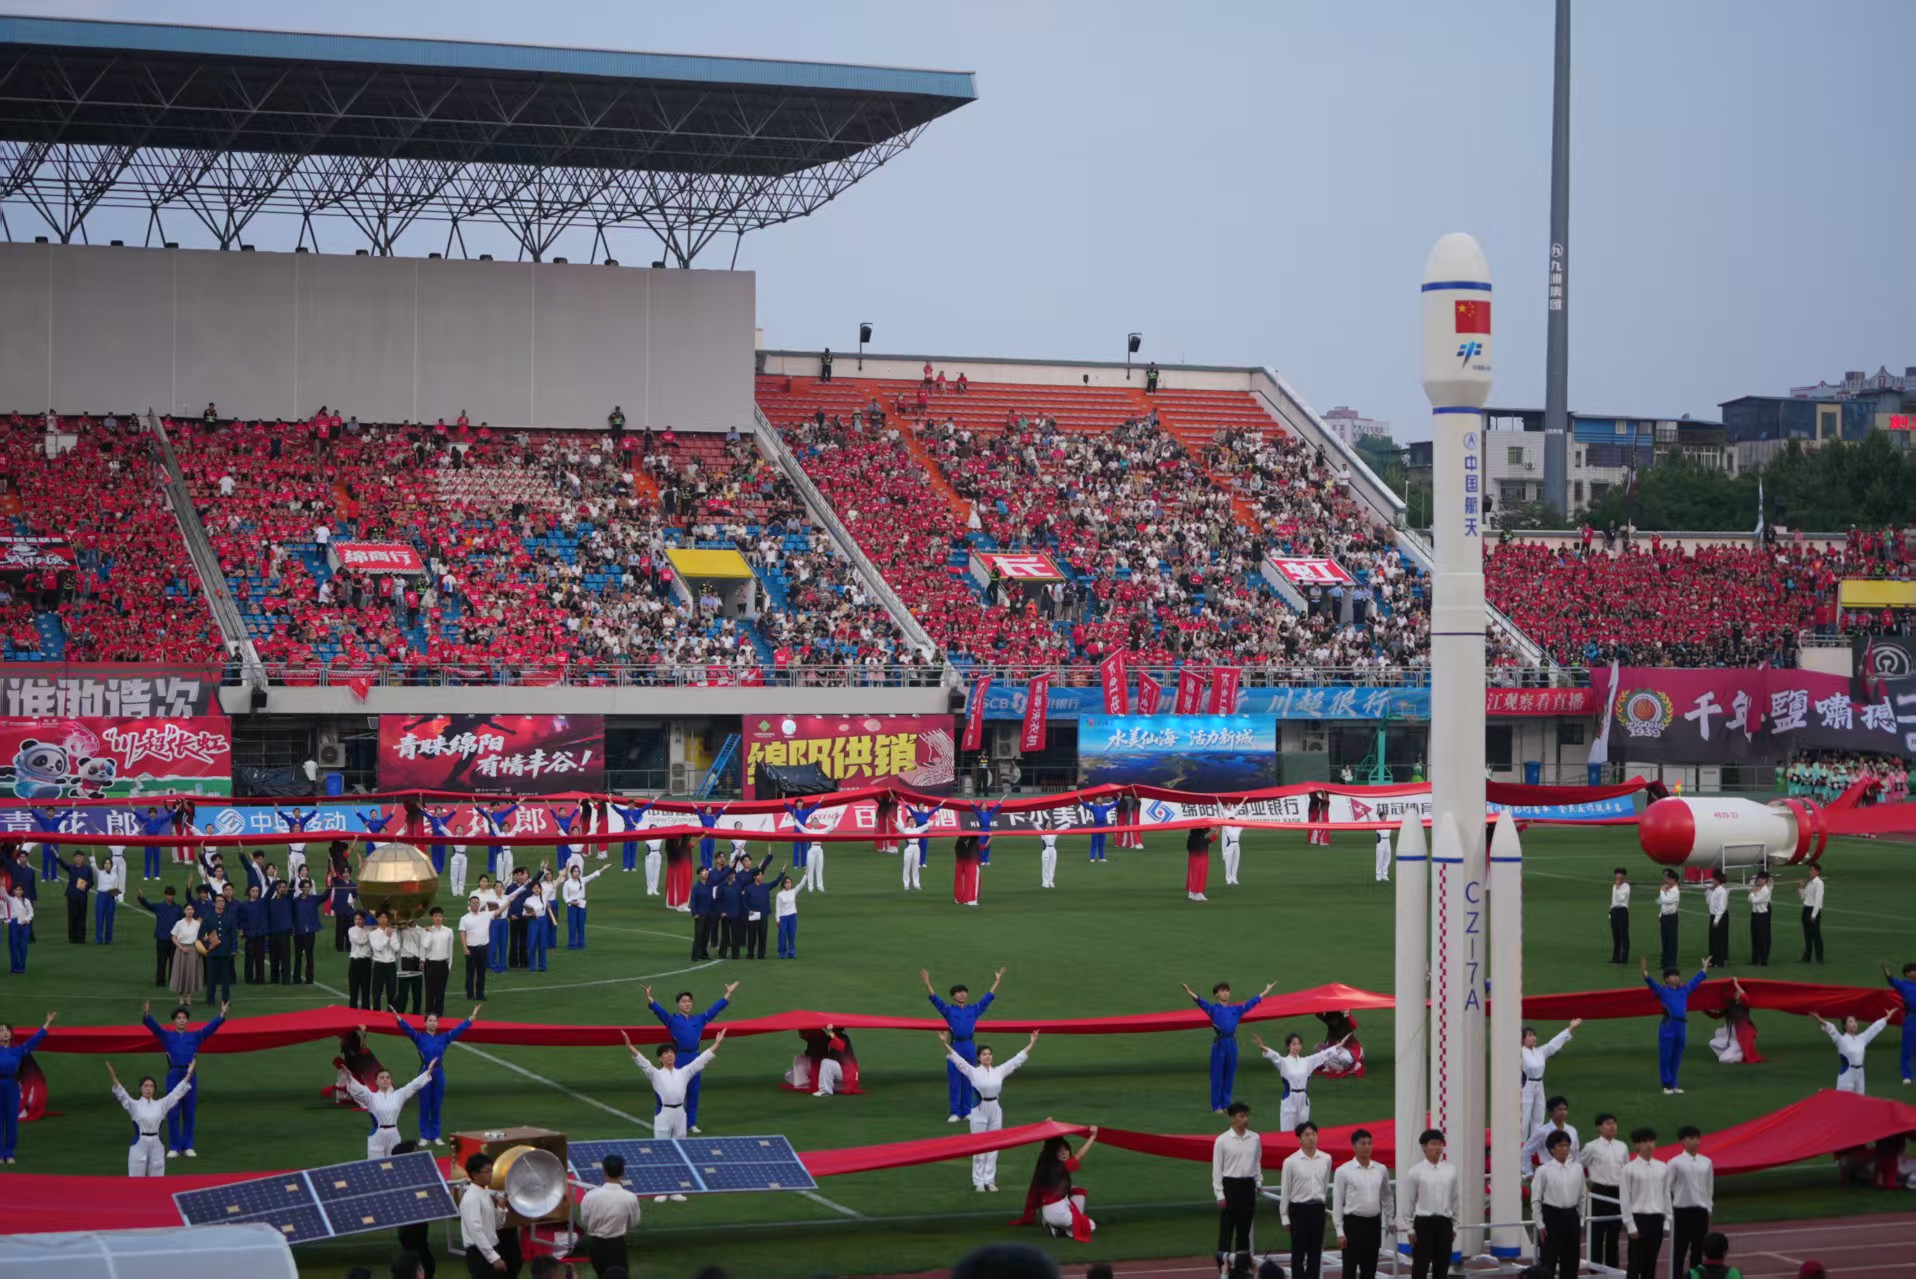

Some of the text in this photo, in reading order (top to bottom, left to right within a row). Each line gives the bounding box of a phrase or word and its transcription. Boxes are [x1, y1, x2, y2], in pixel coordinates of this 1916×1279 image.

[1464, 455, 1478, 537] 中国航天
[1625, 721, 1665, 731] ZIGONG
[1629, 728, 1661, 738] 1939
[393, 731, 504, 760] 青睐绵阳
[1105, 727, 1257, 751] 水美仙海 活力新城
[1181, 798, 1300, 817] 绵阳商业银行
